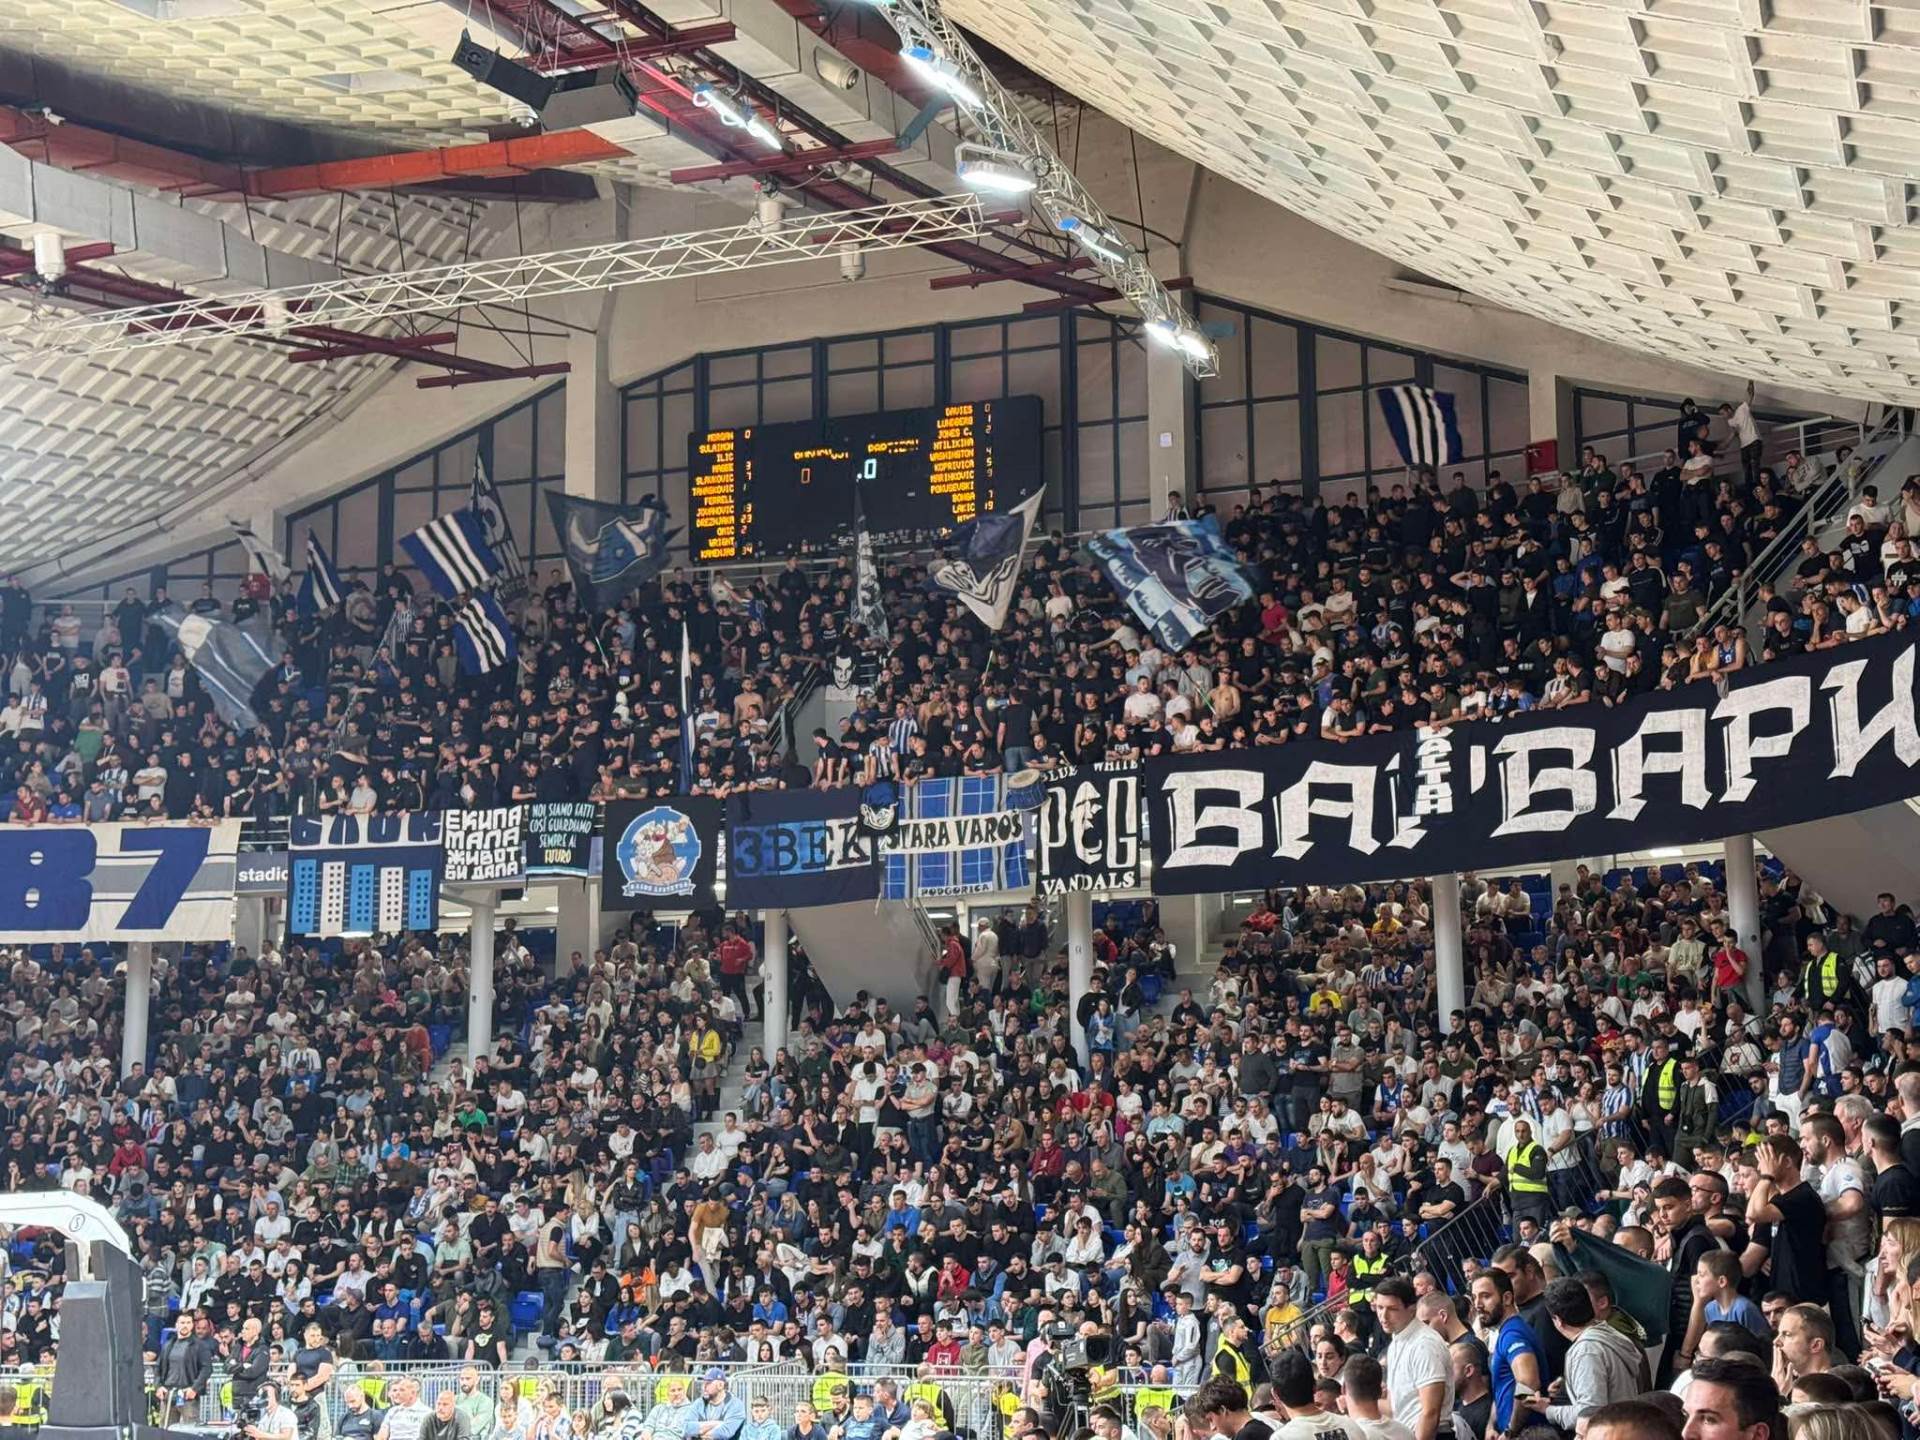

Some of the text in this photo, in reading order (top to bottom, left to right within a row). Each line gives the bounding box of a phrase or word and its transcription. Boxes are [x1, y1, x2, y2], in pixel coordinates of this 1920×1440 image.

[945, 403, 991, 417] DAVIES 0
[744, 429, 751, 439] 0
[938, 425, 992, 439] JONES C. 2
[716, 452, 734, 462] ILIC
[930, 448, 974, 461] WASHINGTON
[934, 459, 975, 472] KOPRIVICA
[801, 468, 810, 484] 0
[930, 470, 975, 483] MARINKOVIC
[930, 481, 974, 494] POKUSEVSKI
[952, 503, 976, 514] LAKIC
[1093, 759, 1138, 772] WHITE
[532, 802, 595, 819] NOI SIAMO FATTI
[548, 818, 592, 834] GUARDIAMO
[539, 833, 567, 848] SEMPRE
[884, 821, 950, 850] STARA
[445, 864, 468, 880] БИ
[921, 883, 990, 897] PODGORICA
[1041, 871, 1135, 896] VANDALS
